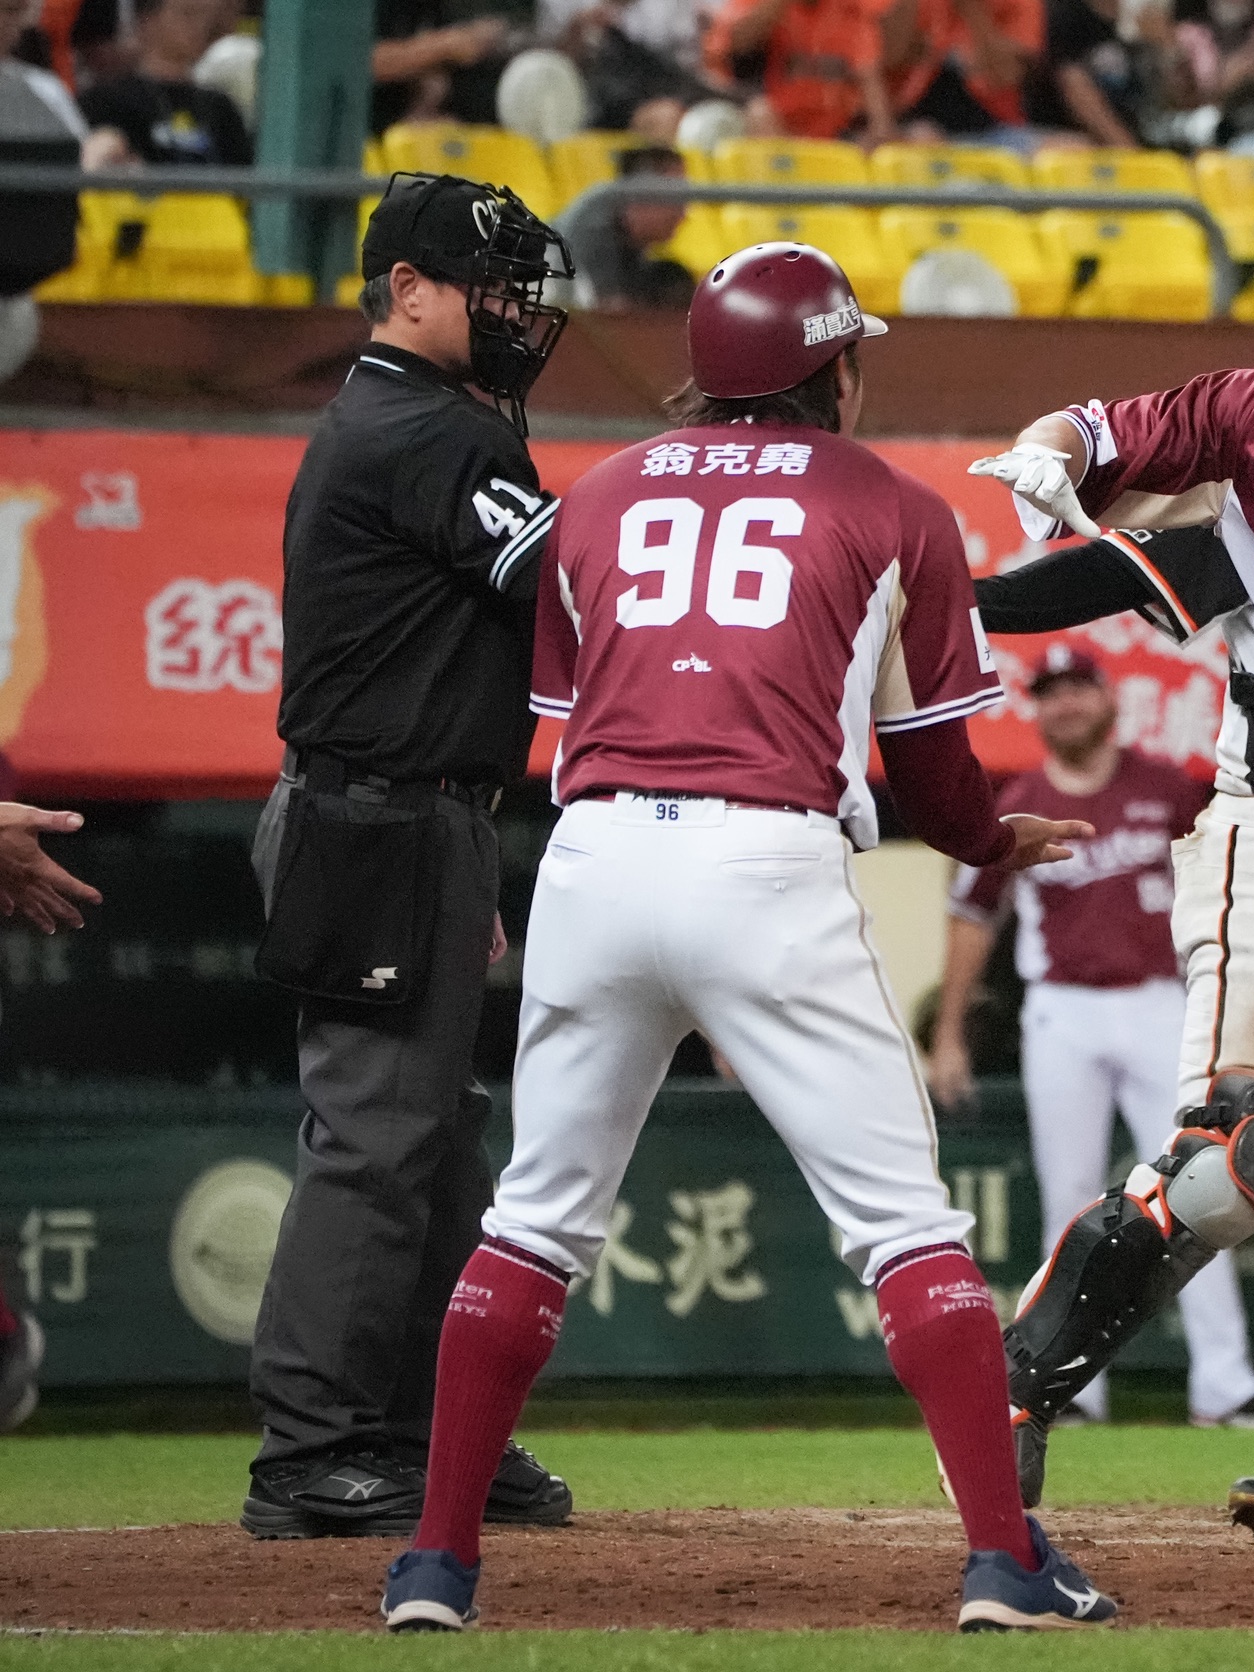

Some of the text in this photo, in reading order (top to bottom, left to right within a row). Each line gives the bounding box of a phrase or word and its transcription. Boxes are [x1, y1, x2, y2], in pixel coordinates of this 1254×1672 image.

[472, 477, 544, 538] 41
[615, 496, 807, 630] 96
[655, 803, 679, 820] 96
